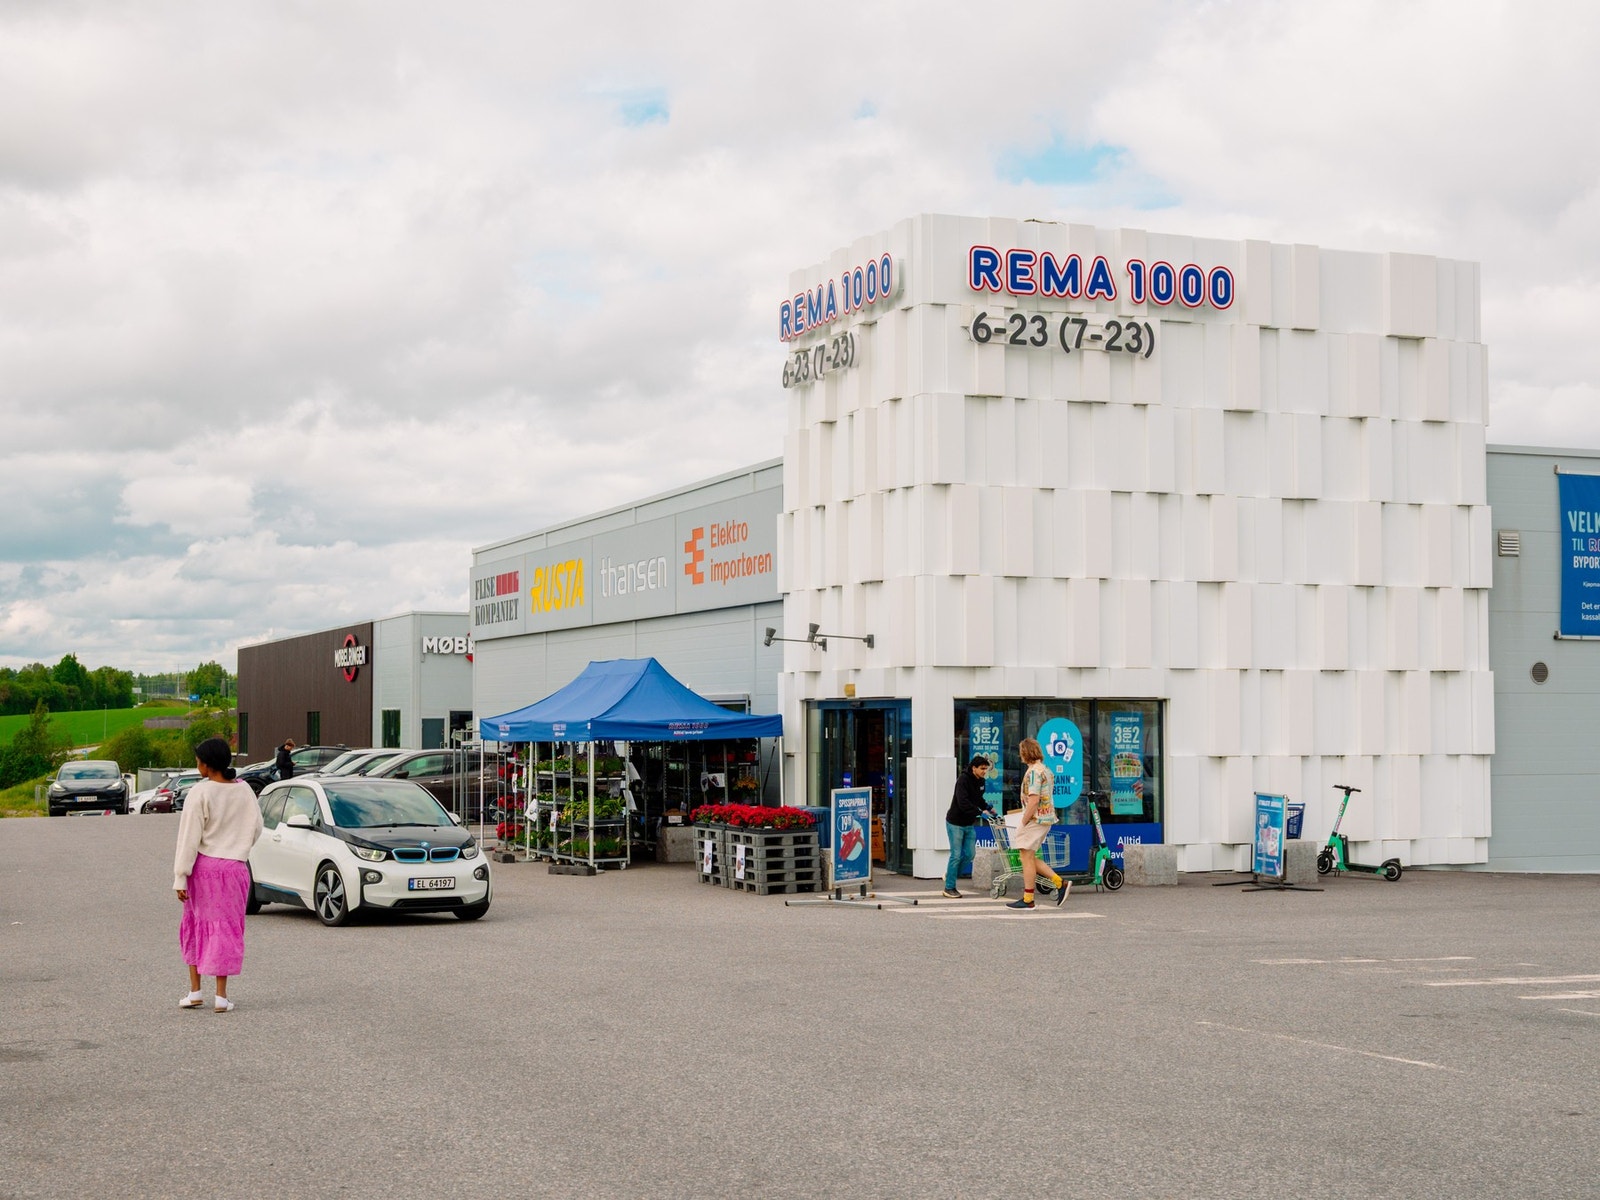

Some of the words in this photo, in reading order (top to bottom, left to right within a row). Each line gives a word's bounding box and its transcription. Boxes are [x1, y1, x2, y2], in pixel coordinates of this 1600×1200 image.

[968, 245, 1117, 301] REMA
[1127, 258, 1235, 310] 1000
[779, 278, 837, 343] REMA
[842, 252, 893, 315] 1000
[972, 311, 1049, 347] 6-23
[1060, 315, 1155, 358] (7-23)
[782, 350, 810, 388] 6-23
[813, 332, 856, 377] (7-23)
[710, 520, 748, 549] Elektro
[1572, 538, 1585, 551] TIL
[600, 556, 667, 598] thansen
[710, 552, 773, 585] importøren
[475, 576, 495, 600] FLISE
[530, 558, 585, 614] RUSTA
[475, 598, 519, 626] KOMPANIET
[1581, 602, 1593, 610] Det
[973, 726, 981, 744] 3
[981, 727, 991, 744] FOR
[992, 726, 1000, 744] 2
[1115, 725, 1122, 743] 3
[1122, 727, 1132, 743] FOR
[1132, 726, 1140, 743] 2
[1053, 786, 1071, 794] BETAL
[1117, 836, 1141, 845] Alltid
[417, 880, 426, 888] EL
[428, 879, 452, 888] 64197
